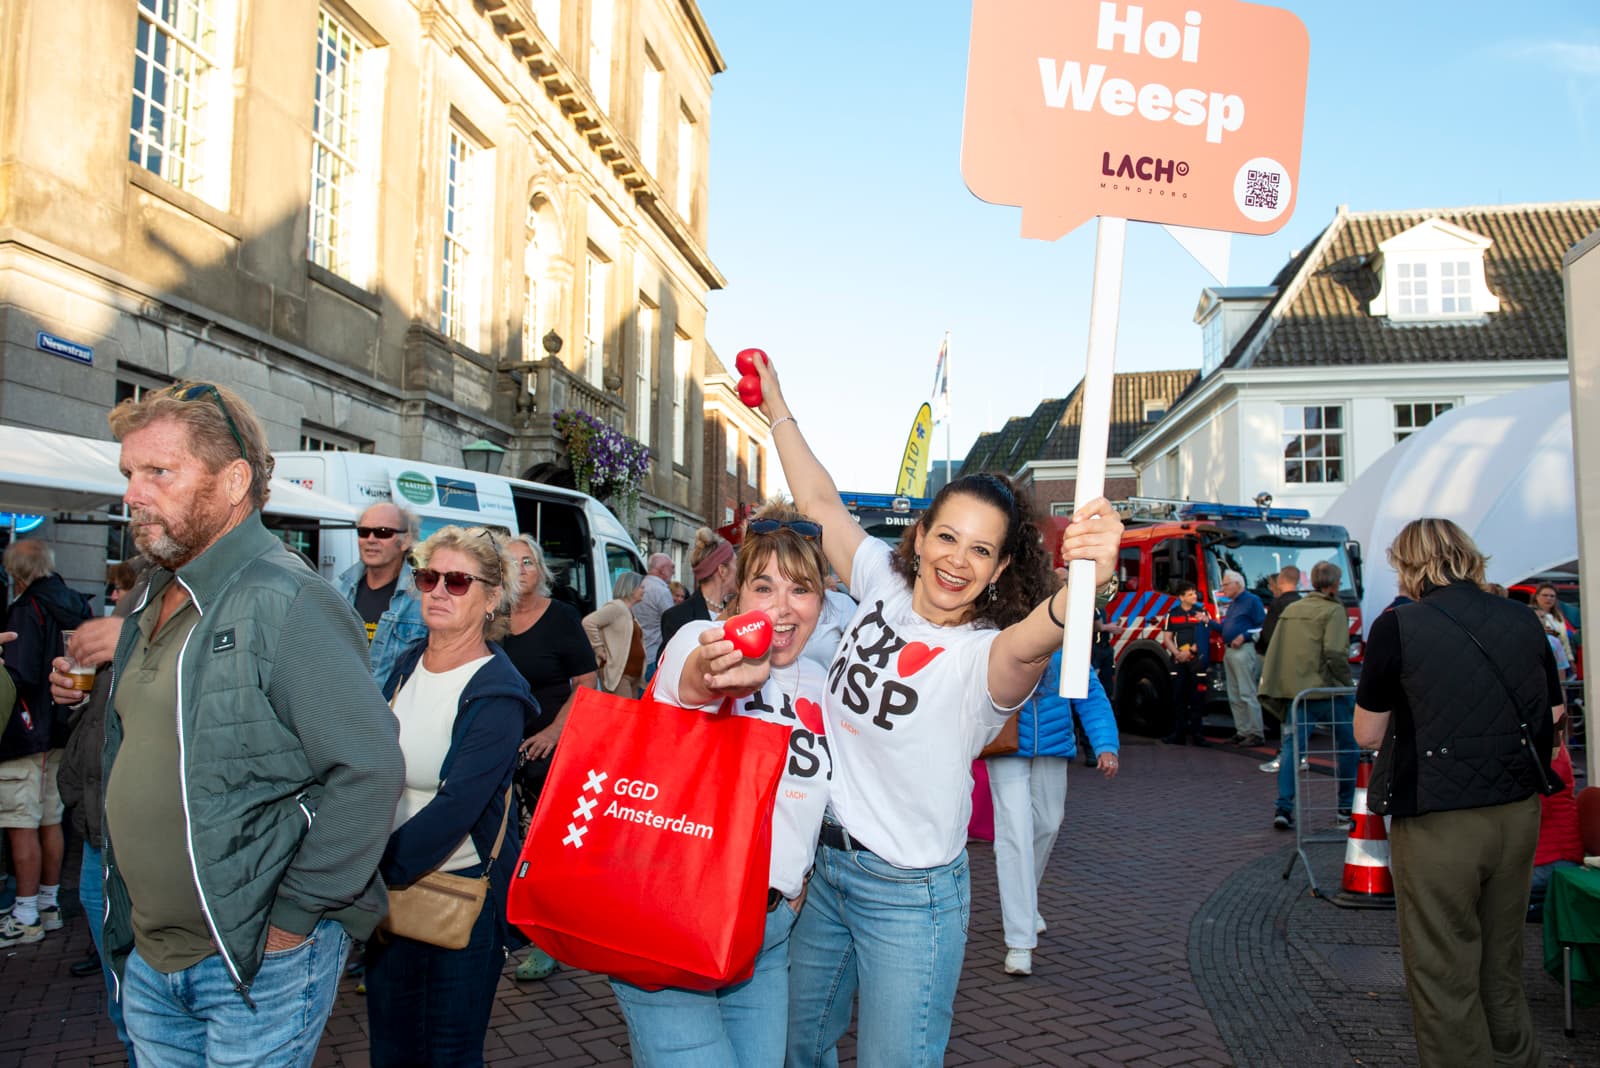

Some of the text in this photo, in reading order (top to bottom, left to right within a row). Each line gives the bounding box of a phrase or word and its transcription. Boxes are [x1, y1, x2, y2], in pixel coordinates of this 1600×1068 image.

[1097, 2, 1202, 63] Hoi
[1038, 57, 1245, 144] Weesp
[1102, 151, 1175, 184] LACH
[1100, 183, 1188, 199] MONDZORG
[42, 335, 91, 360] Nieuwstraat
[1265, 523, 1310, 539] Weesp
[736, 621, 761, 636] LACH
[613, 777, 659, 801] GGD
[603, 800, 714, 840] Amsterdam
